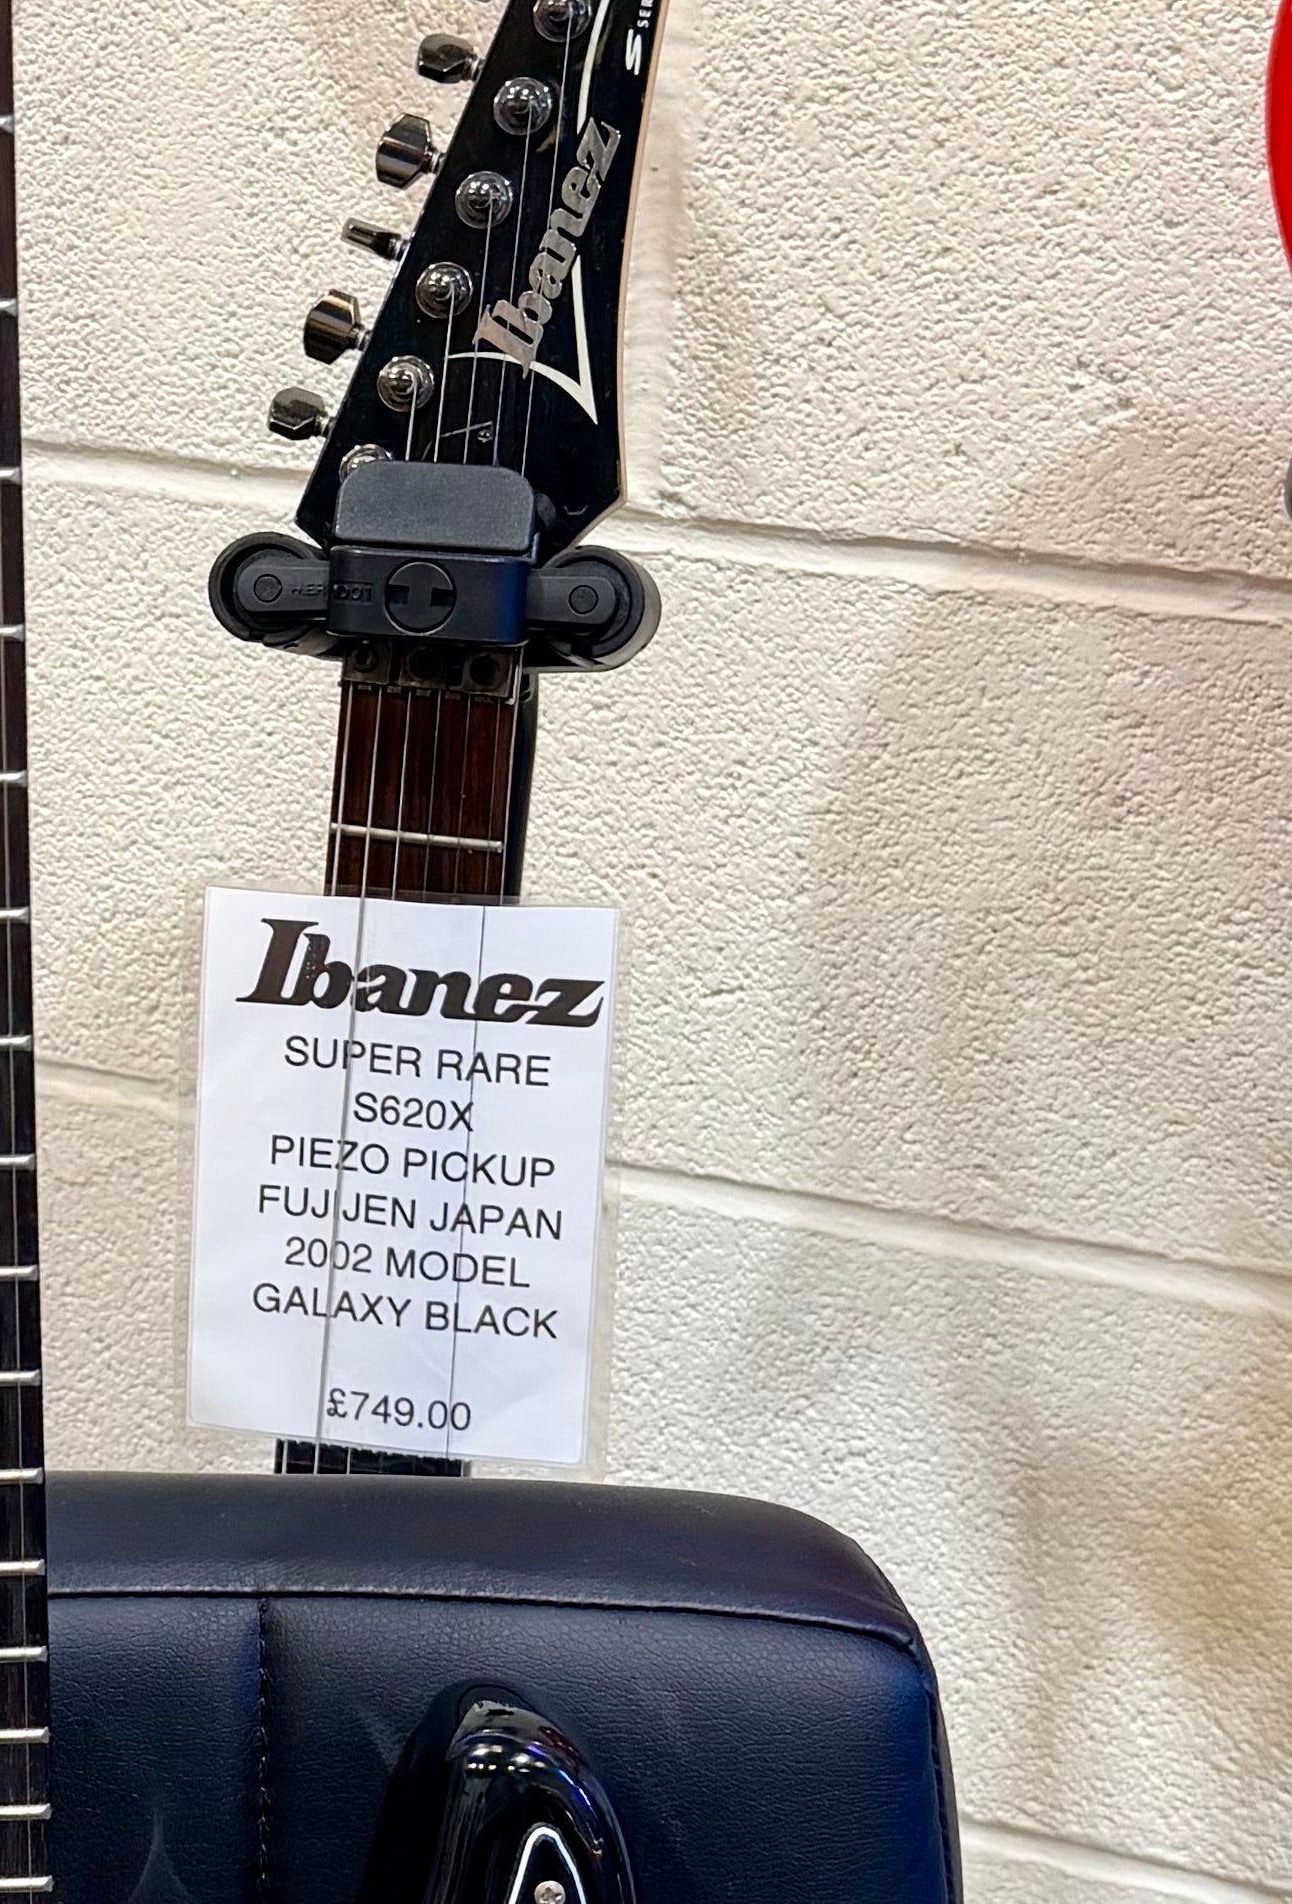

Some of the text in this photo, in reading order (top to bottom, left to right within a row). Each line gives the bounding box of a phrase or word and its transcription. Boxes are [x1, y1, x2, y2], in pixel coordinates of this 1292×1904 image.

[472, 116, 622, 380] Ibanez
[235, 918, 605, 1028] Ibanez
[285, 1036, 552, 1087] SUPER RARE
[354, 1091, 474, 1132] S620X
[271, 1135, 555, 1188] PIEZO PICKUP
[430, 1203, 563, 1240] JAPAN
[285, 1237, 531, 1287] 2002 MODEL
[253, 1283, 559, 1339] GALAXY BLACK
[326, 1389, 471, 1431] £749.00
